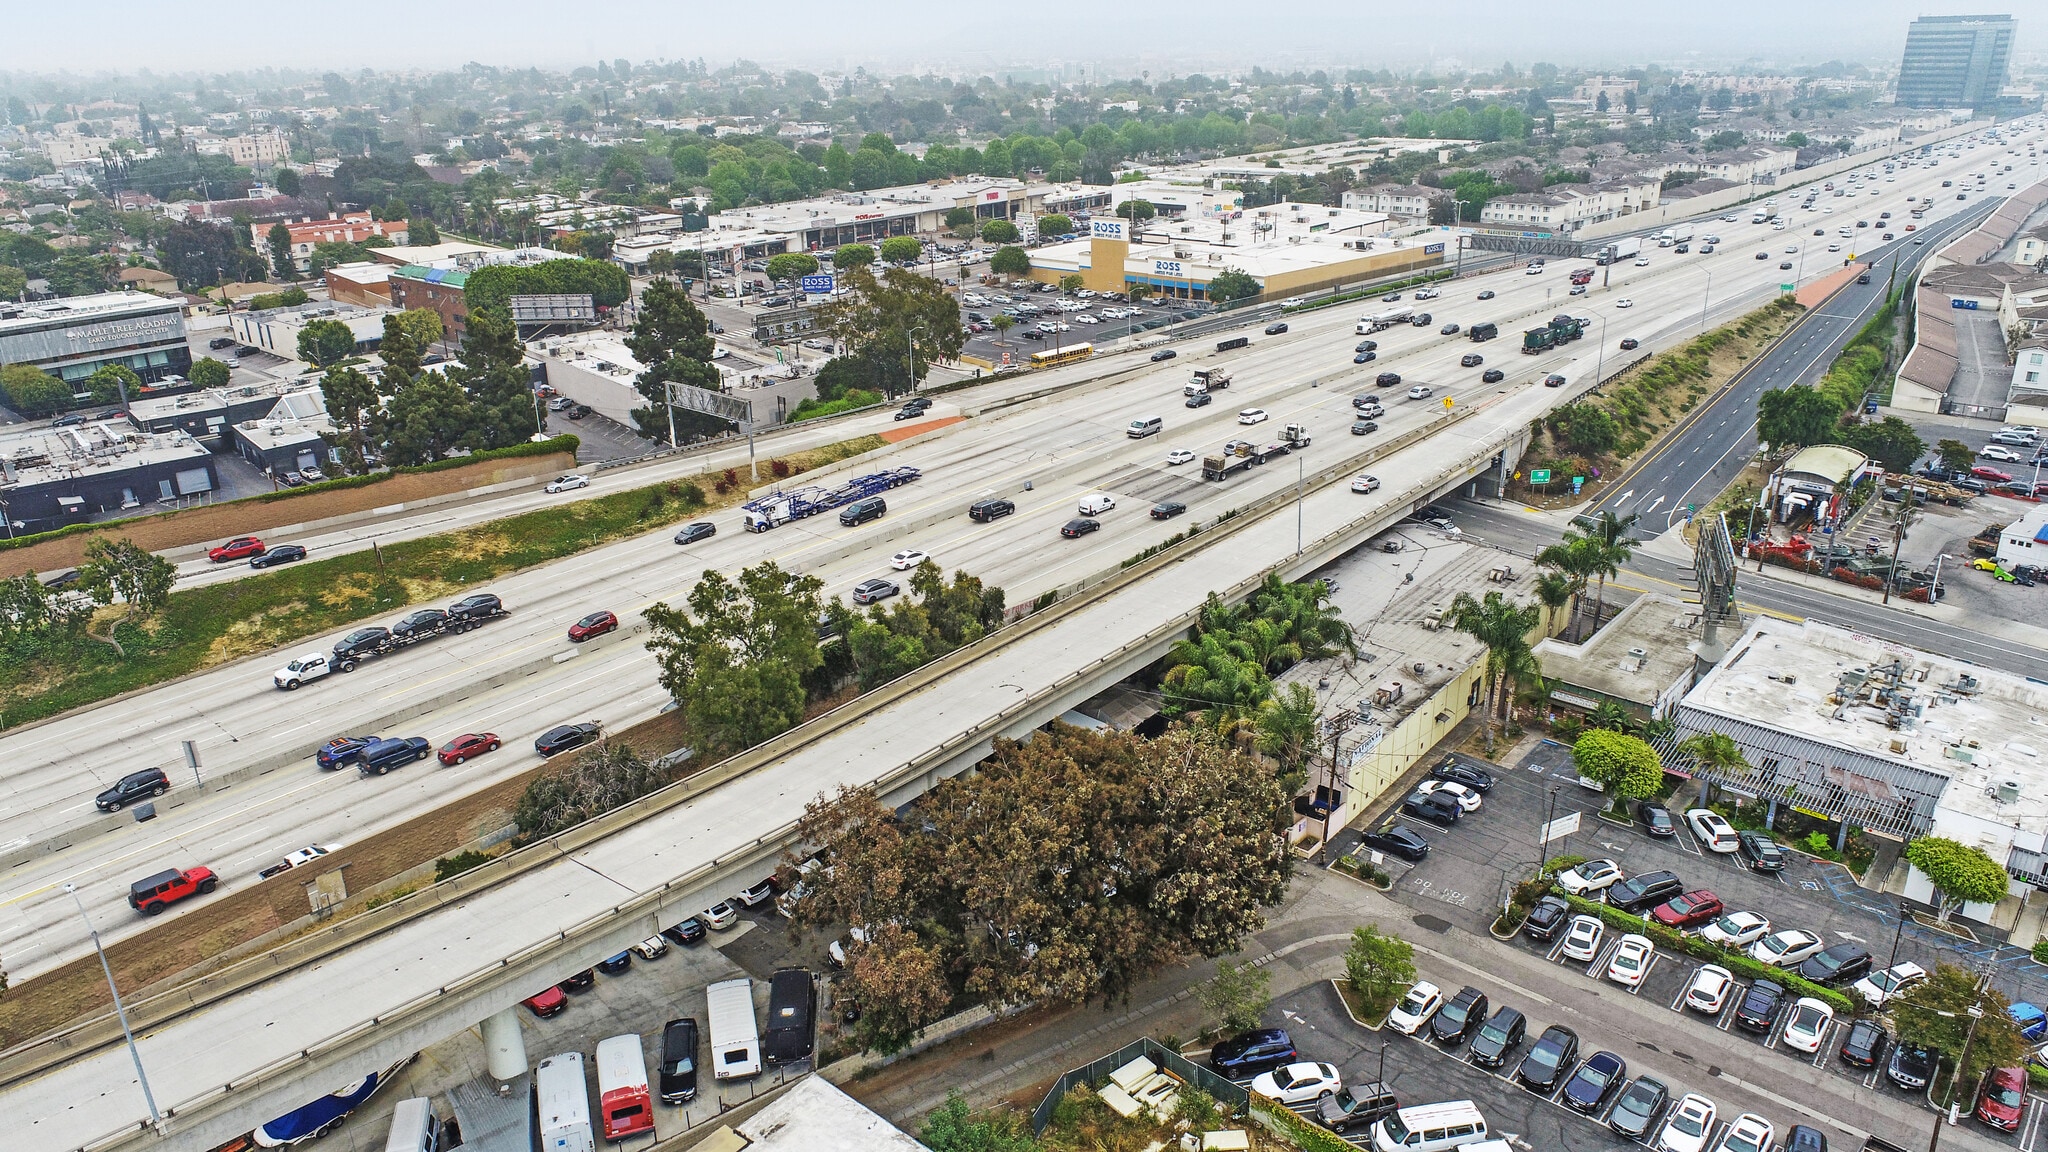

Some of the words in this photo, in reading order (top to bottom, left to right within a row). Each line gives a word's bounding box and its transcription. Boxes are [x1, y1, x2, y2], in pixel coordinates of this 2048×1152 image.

[1094, 222, 1121, 234] ROSS
[1156, 261, 1181, 271] ROSS
[804, 277, 830, 286] ROSS
[77, 328, 108, 339] MAPLE
[110, 325, 134, 334] TREE
[135, 317, 178, 330] ACADEMY
[88, 336, 107, 344] EARLY
[108, 331, 144, 341] EDUCATION
[145, 327, 169, 335] CENTER
[1354, 730, 1381, 756] NATIONAL
[1414, 878, 1432, 888] DO
